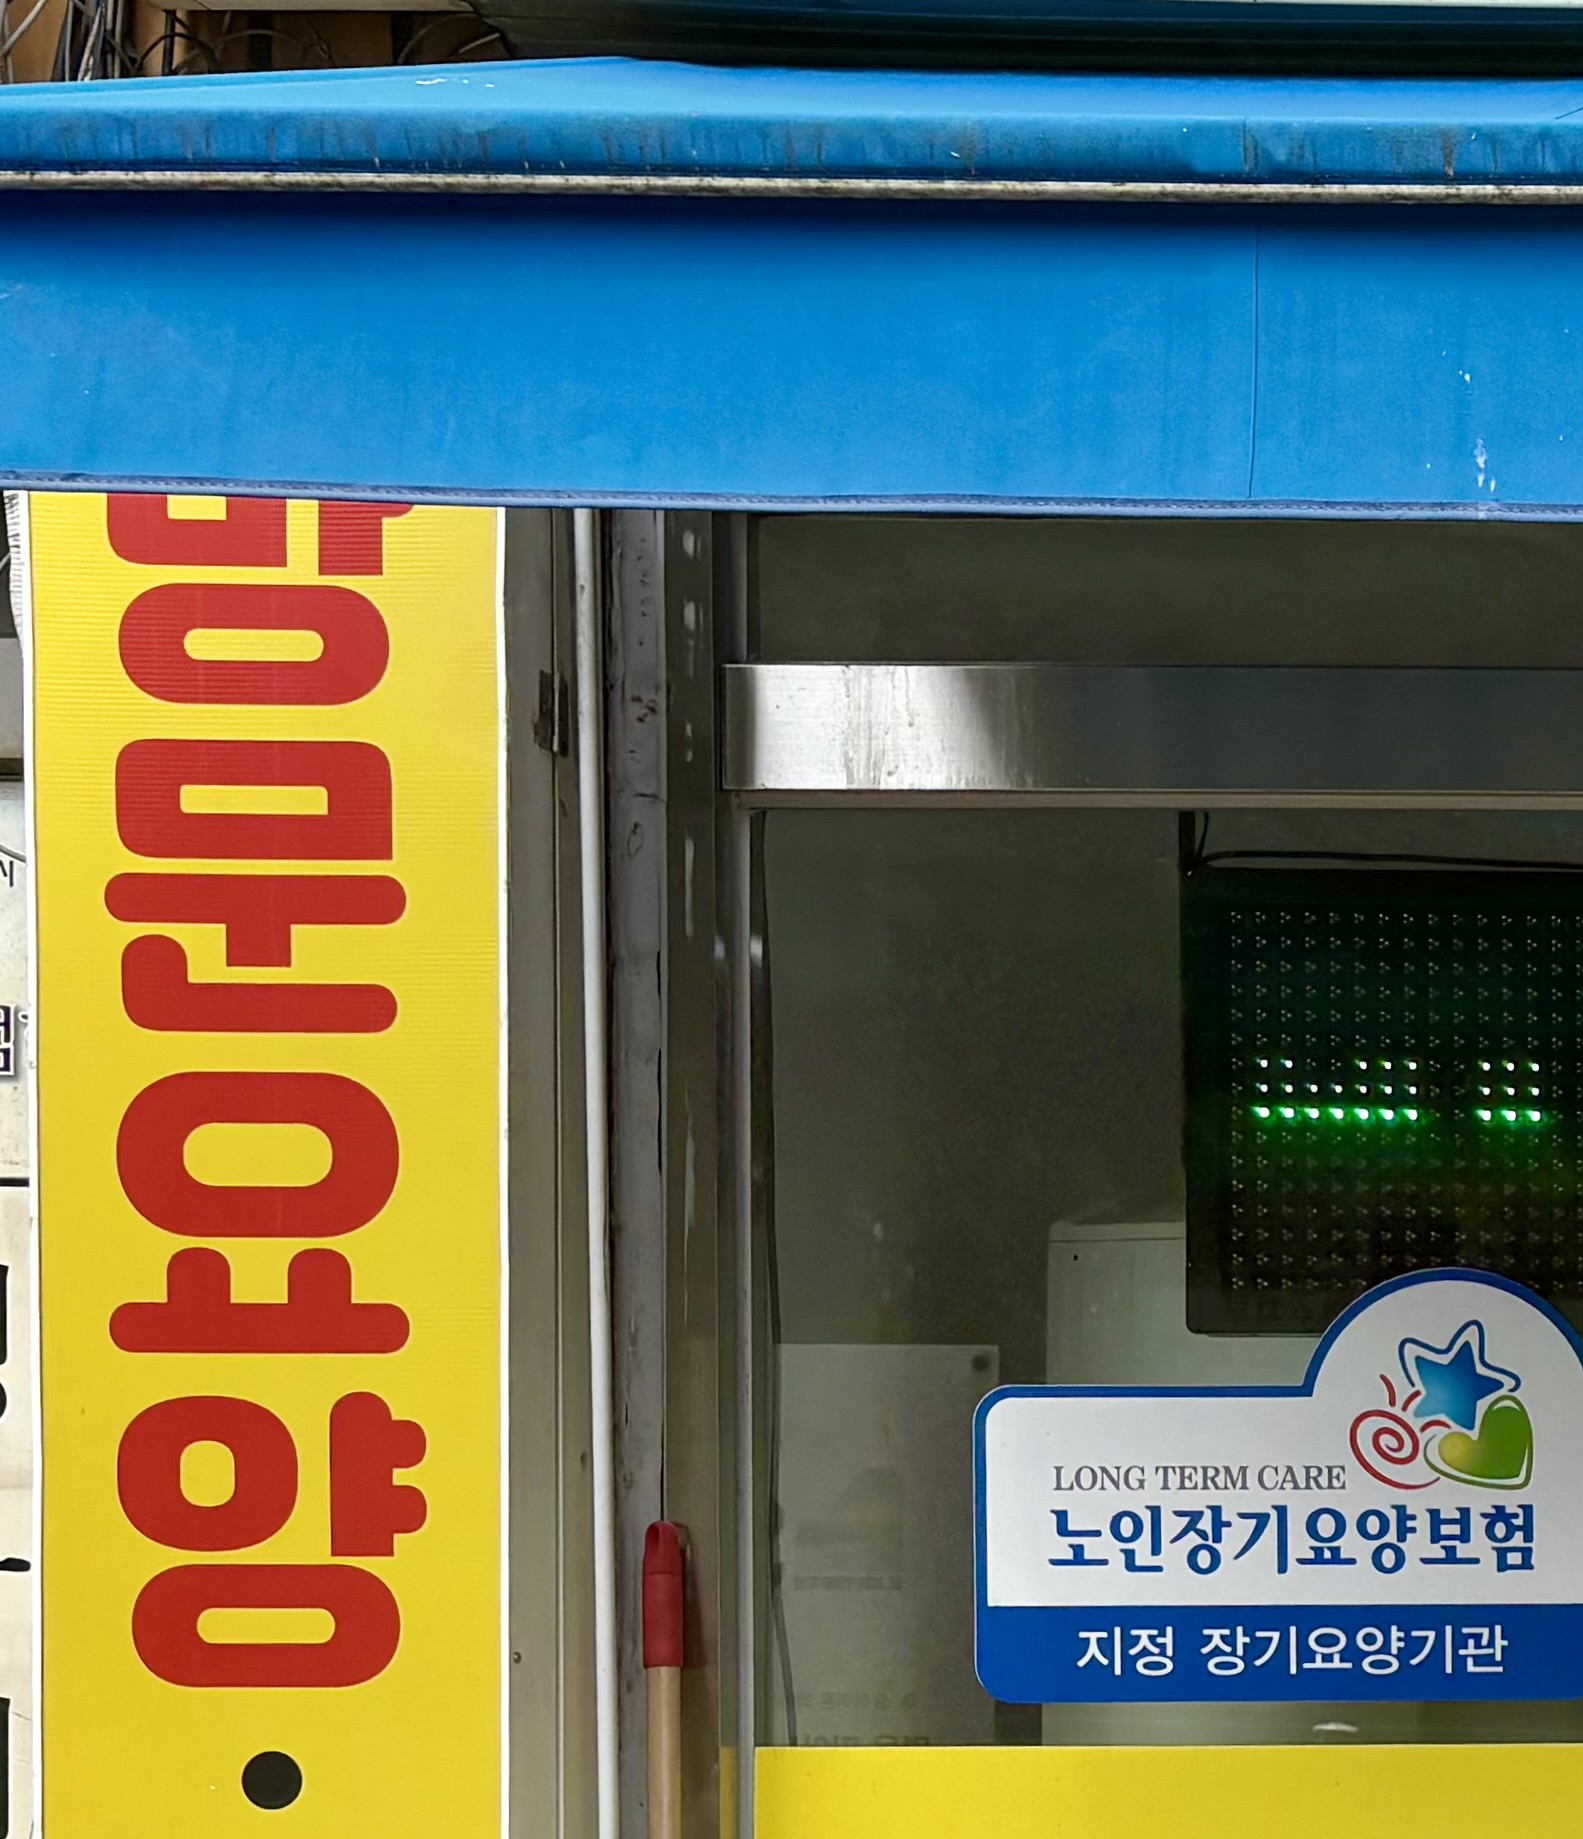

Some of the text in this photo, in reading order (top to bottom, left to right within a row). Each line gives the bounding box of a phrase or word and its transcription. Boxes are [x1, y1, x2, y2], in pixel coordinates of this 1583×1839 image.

[104, 492, 427, 1689] 방문요양
[1053, 1464, 1348, 1493] LONG TERM CARE
[1047, 1503, 1537, 1575] 노인장기요양보험
[1075, 1625, 1510, 1677] 지정 장기요양기관
